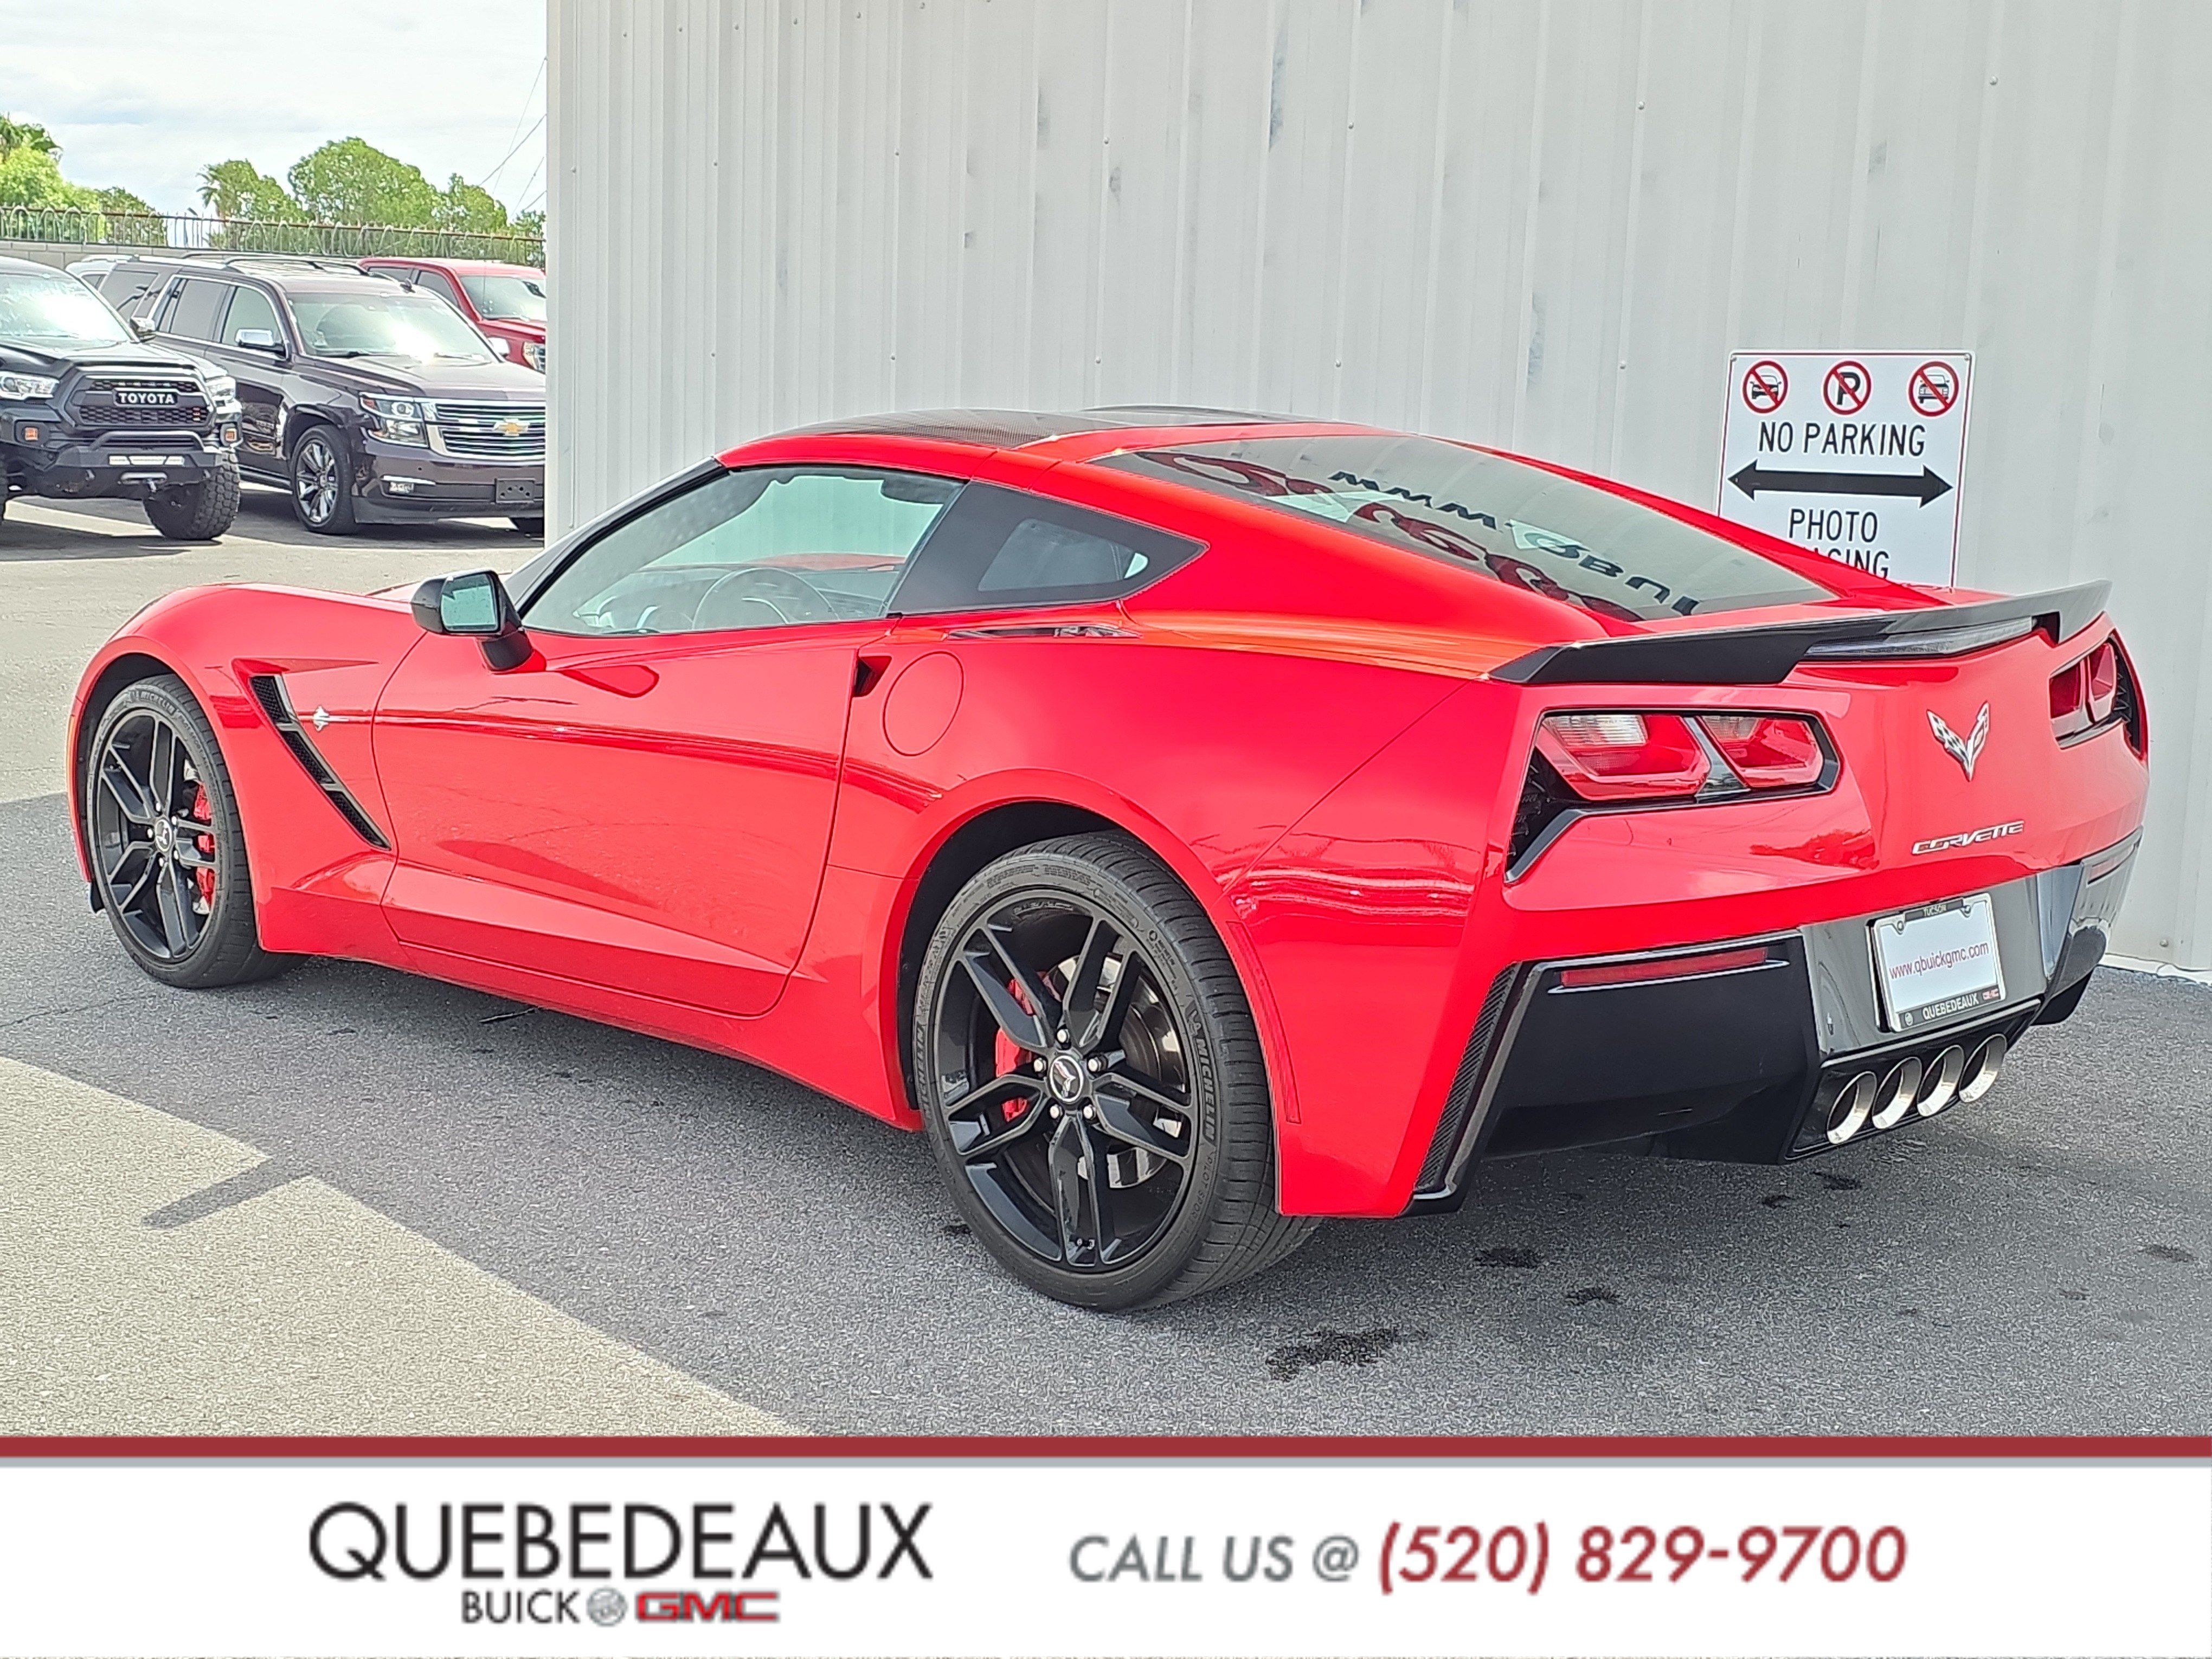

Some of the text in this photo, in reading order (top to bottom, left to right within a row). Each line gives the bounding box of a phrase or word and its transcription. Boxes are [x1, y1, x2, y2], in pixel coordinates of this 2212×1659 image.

[118, 393, 175, 404] TOYOTA
[1759, 421, 1926, 456] NO PARKING
[1789, 509, 1878, 543] PHOTO
[1912, 820, 2024, 854] CORVETTE
[1889, 942, 1989, 979] www.qbuickgmc.com
[1922, 993, 1979, 1020] QUEBEDEAUX
[1196, 1039, 1215, 1140] MICHELIN
